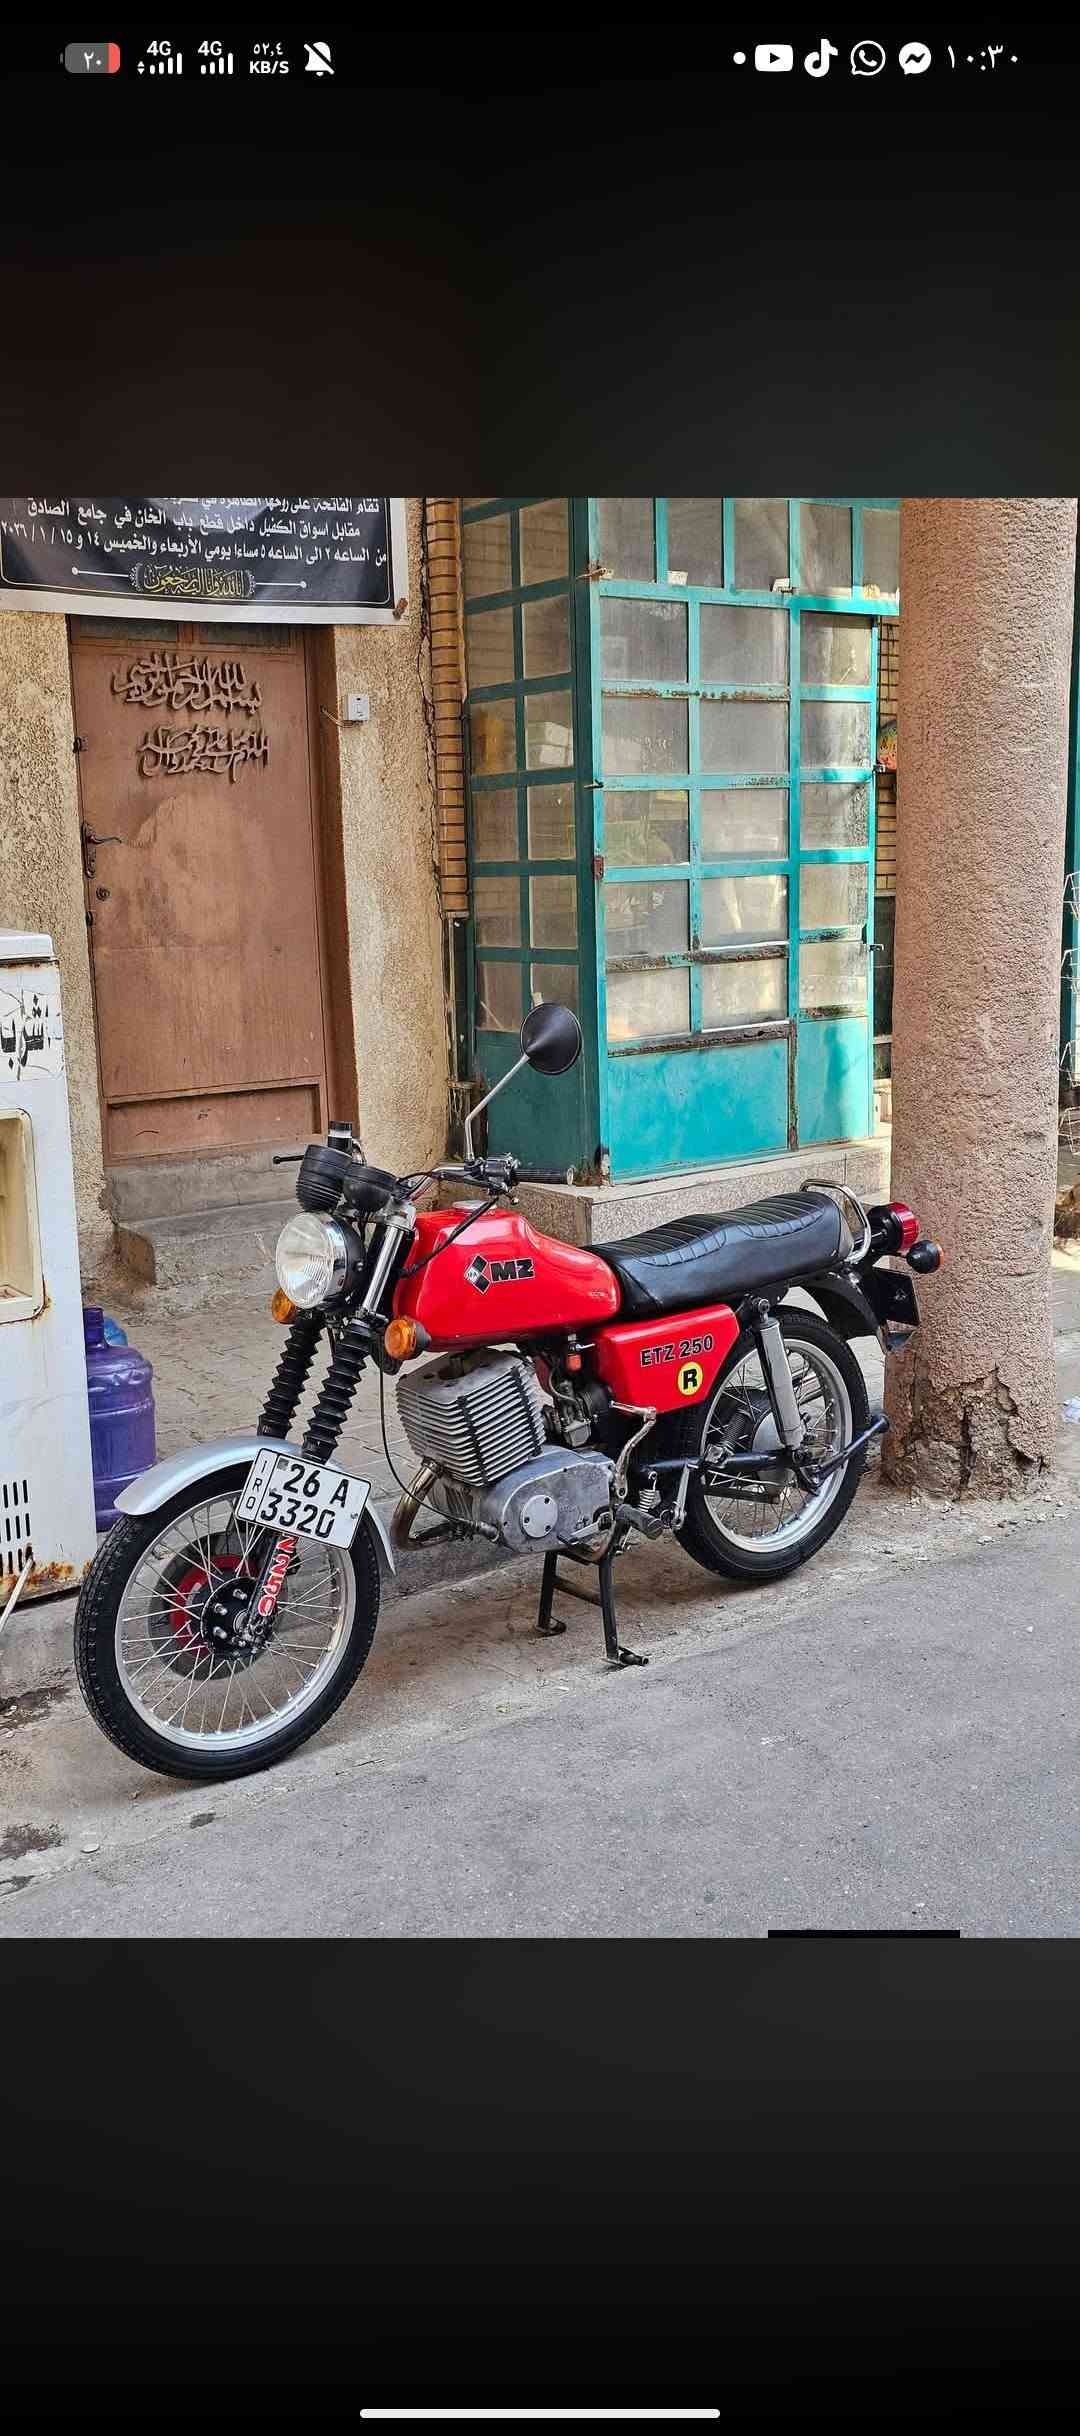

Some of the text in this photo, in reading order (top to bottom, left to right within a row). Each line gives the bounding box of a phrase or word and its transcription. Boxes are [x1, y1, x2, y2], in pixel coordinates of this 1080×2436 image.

[27, 498, 70, 518] الصادق
[78, 502, 107, 526] جامع
[114, 505, 132, 529] في
[134, 506, 167, 528] الخان
[172, 511, 193, 533] باب
[226, 514, 255, 535] داخل
[259, 516, 297, 538] الكفيل
[331, 521, 361, 542] مقابل
[103, 532, 158, 556] والخميس
[204, 544, 232, 563] يومي
[260, 542, 267, 559] ٥
[375, 547, 387, 567] من
[489, 1257, 536, 1284] MZ
[640, 1333, 715, 1367] ETZ 250
[682, 1368, 699, 1391] R
[283, 1463, 350, 1508] 26 A
[260, 1491, 336, 1539] 3320
